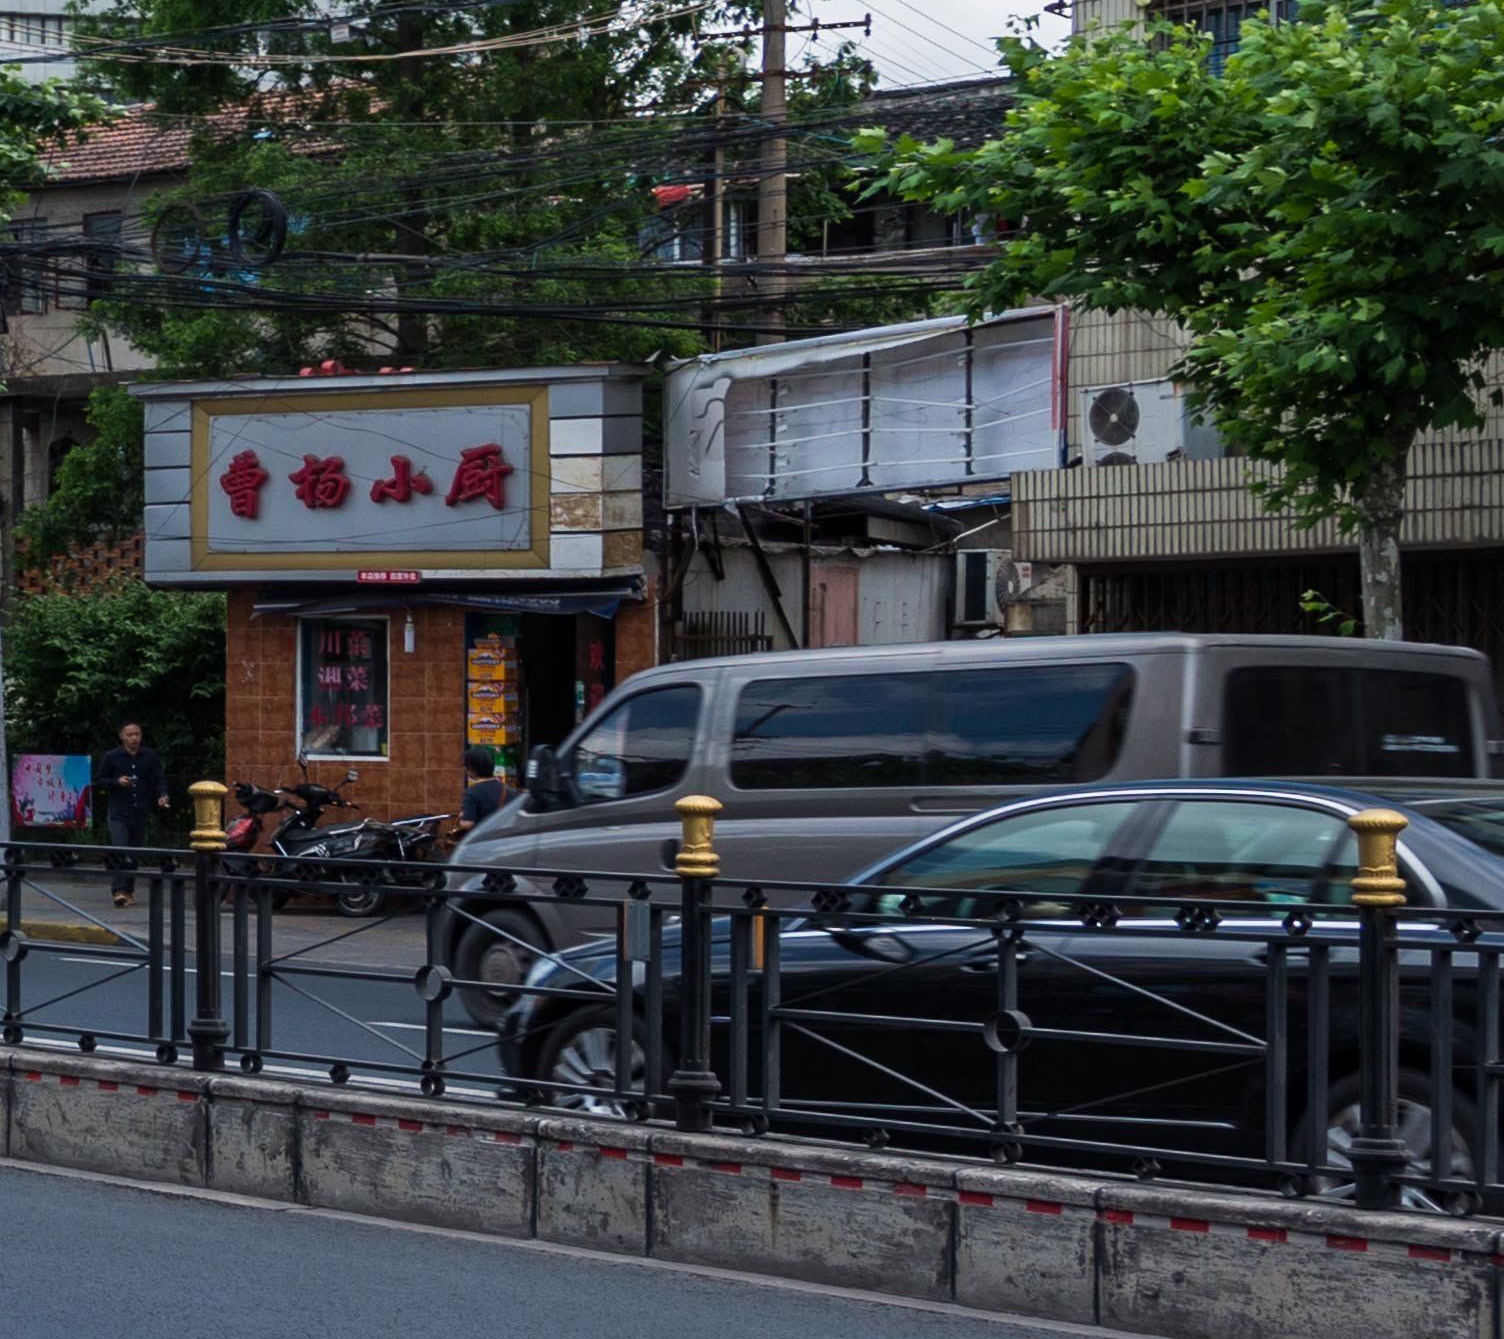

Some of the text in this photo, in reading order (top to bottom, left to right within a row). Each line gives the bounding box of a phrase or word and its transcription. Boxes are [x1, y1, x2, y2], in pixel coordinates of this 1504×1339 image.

[220, 443, 513, 520] 曹杨小厨
[318, 666, 369, 691] 湘菜
